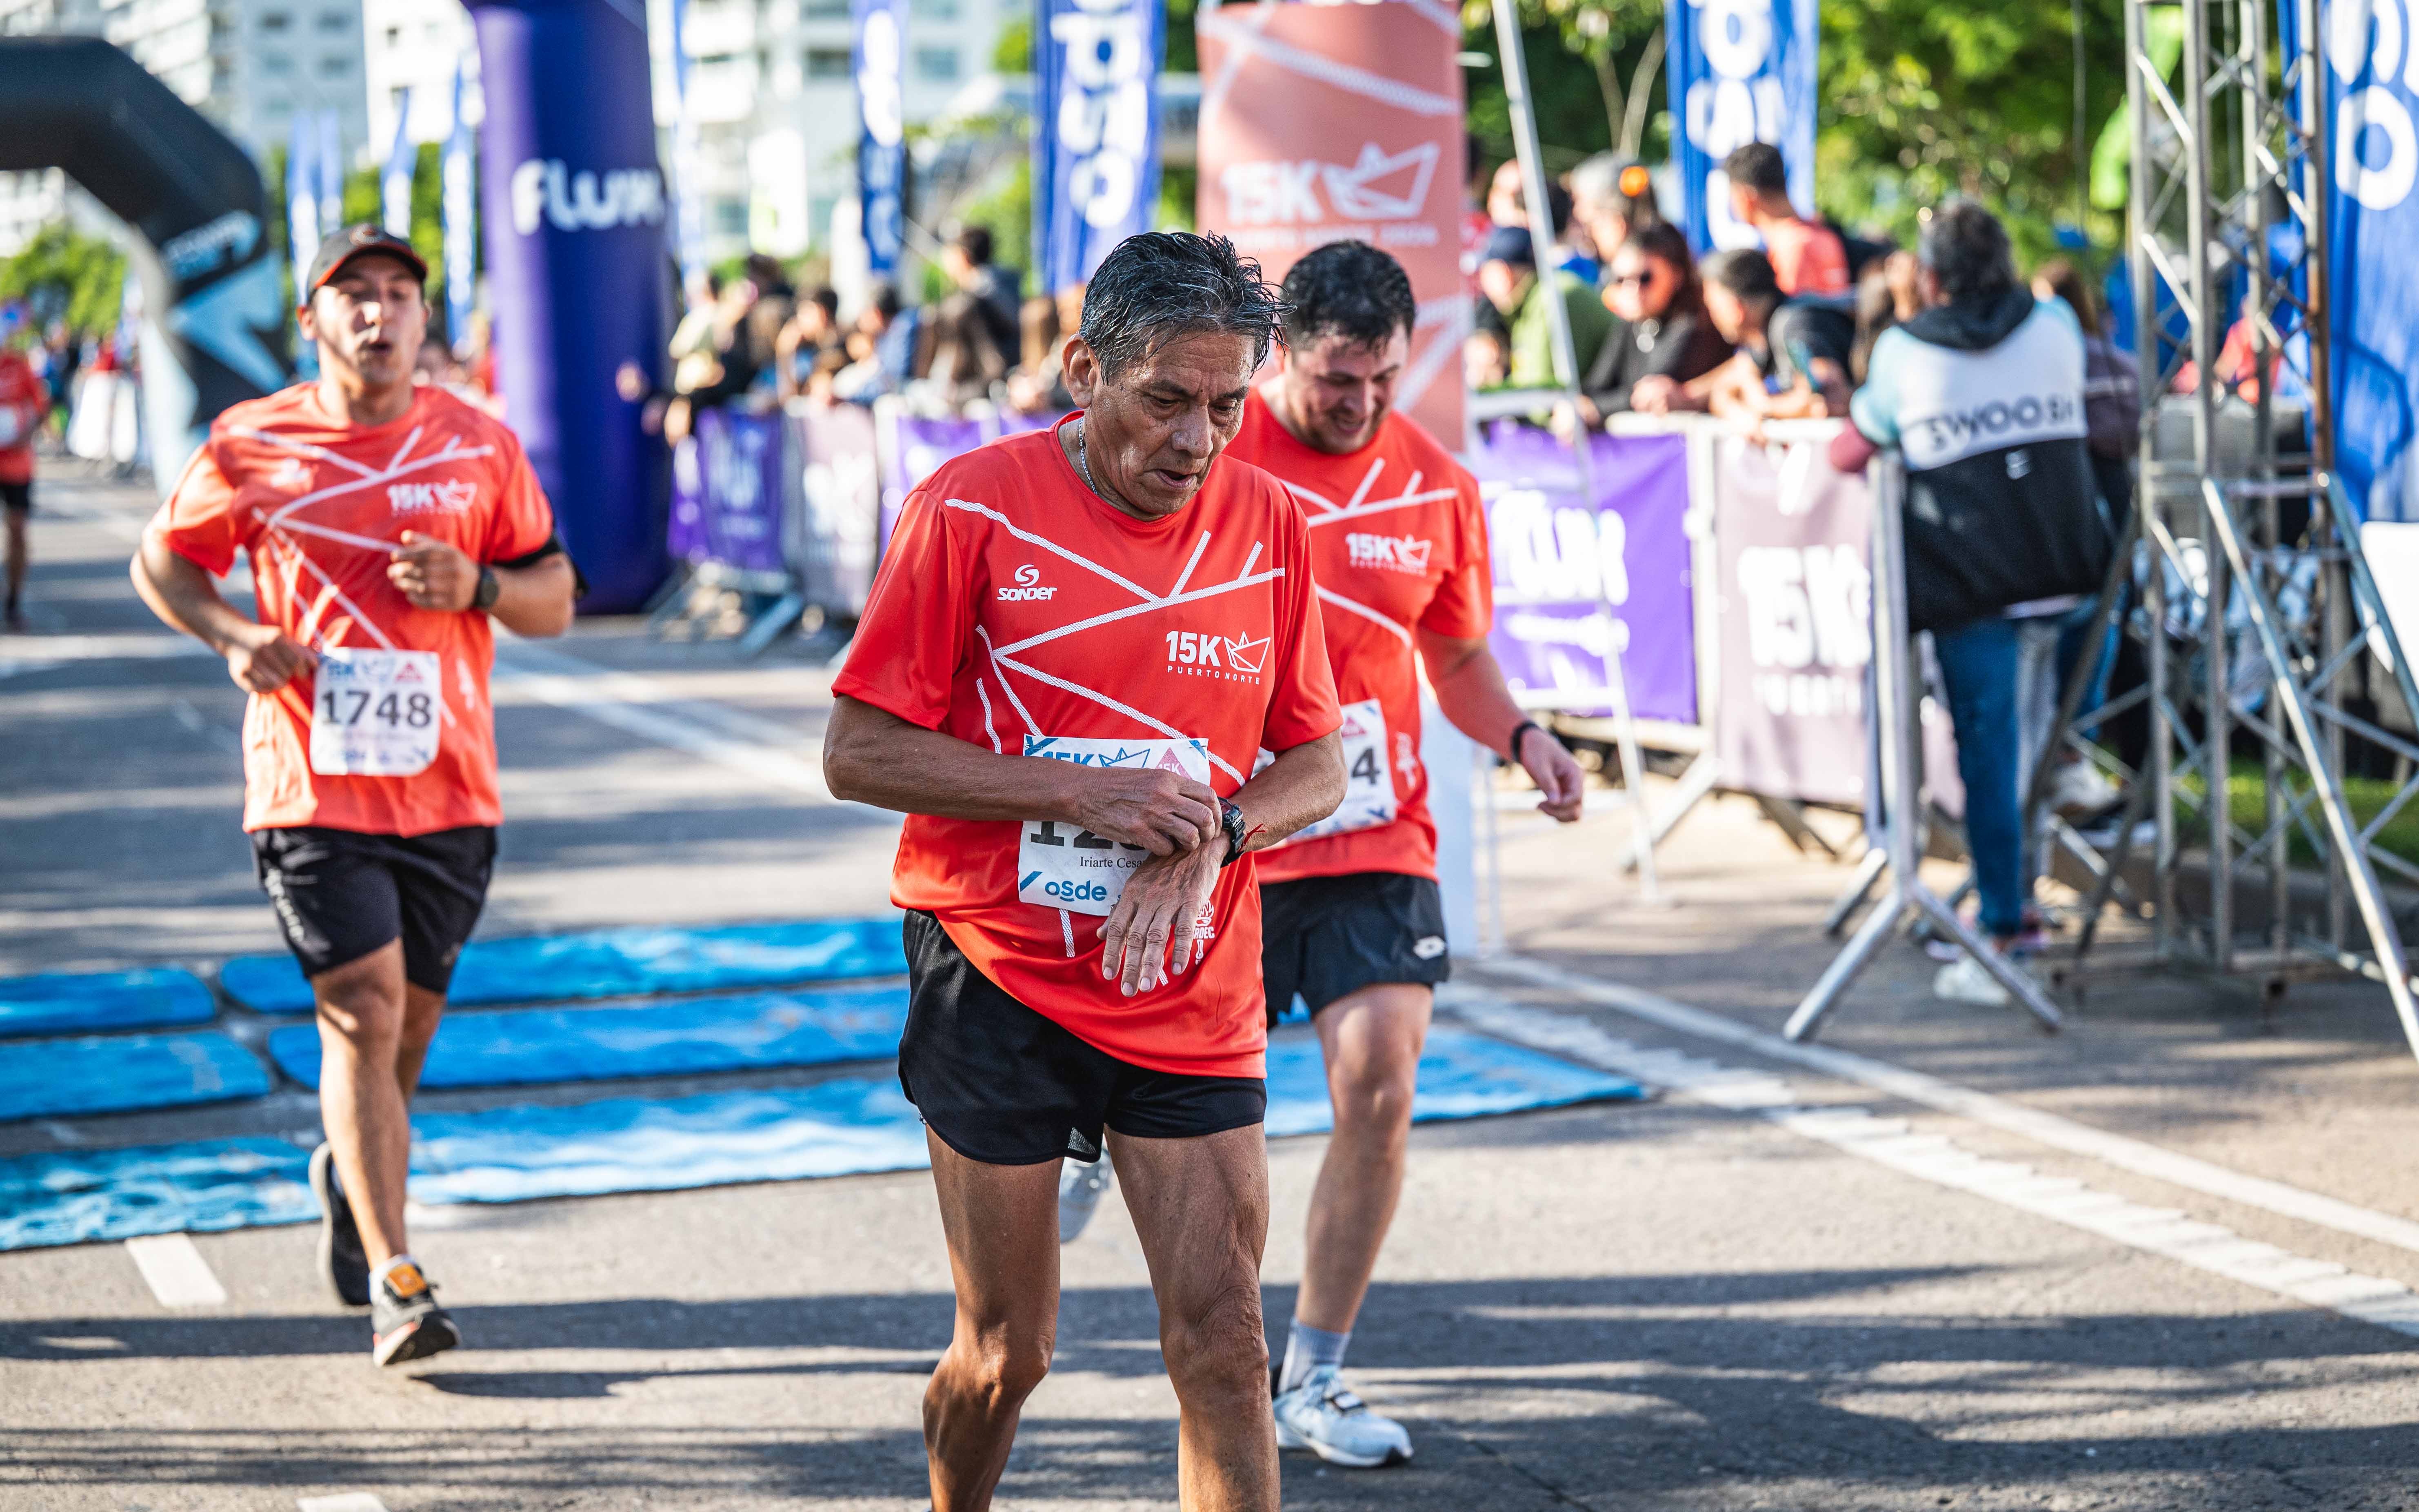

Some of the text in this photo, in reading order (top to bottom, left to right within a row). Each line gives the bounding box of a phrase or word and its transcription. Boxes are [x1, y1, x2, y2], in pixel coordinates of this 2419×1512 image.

[1051, 0, 1148, 229] osd
[1220, 160, 1323, 225] 15K
[1346, 533, 1395, 562] 15K
[1166, 631, 1222, 667] 15K
[322, 690, 431, 728] 1748
[1080, 856, 1113, 867] Iriarte
[1045, 880, 1107, 901] osde
